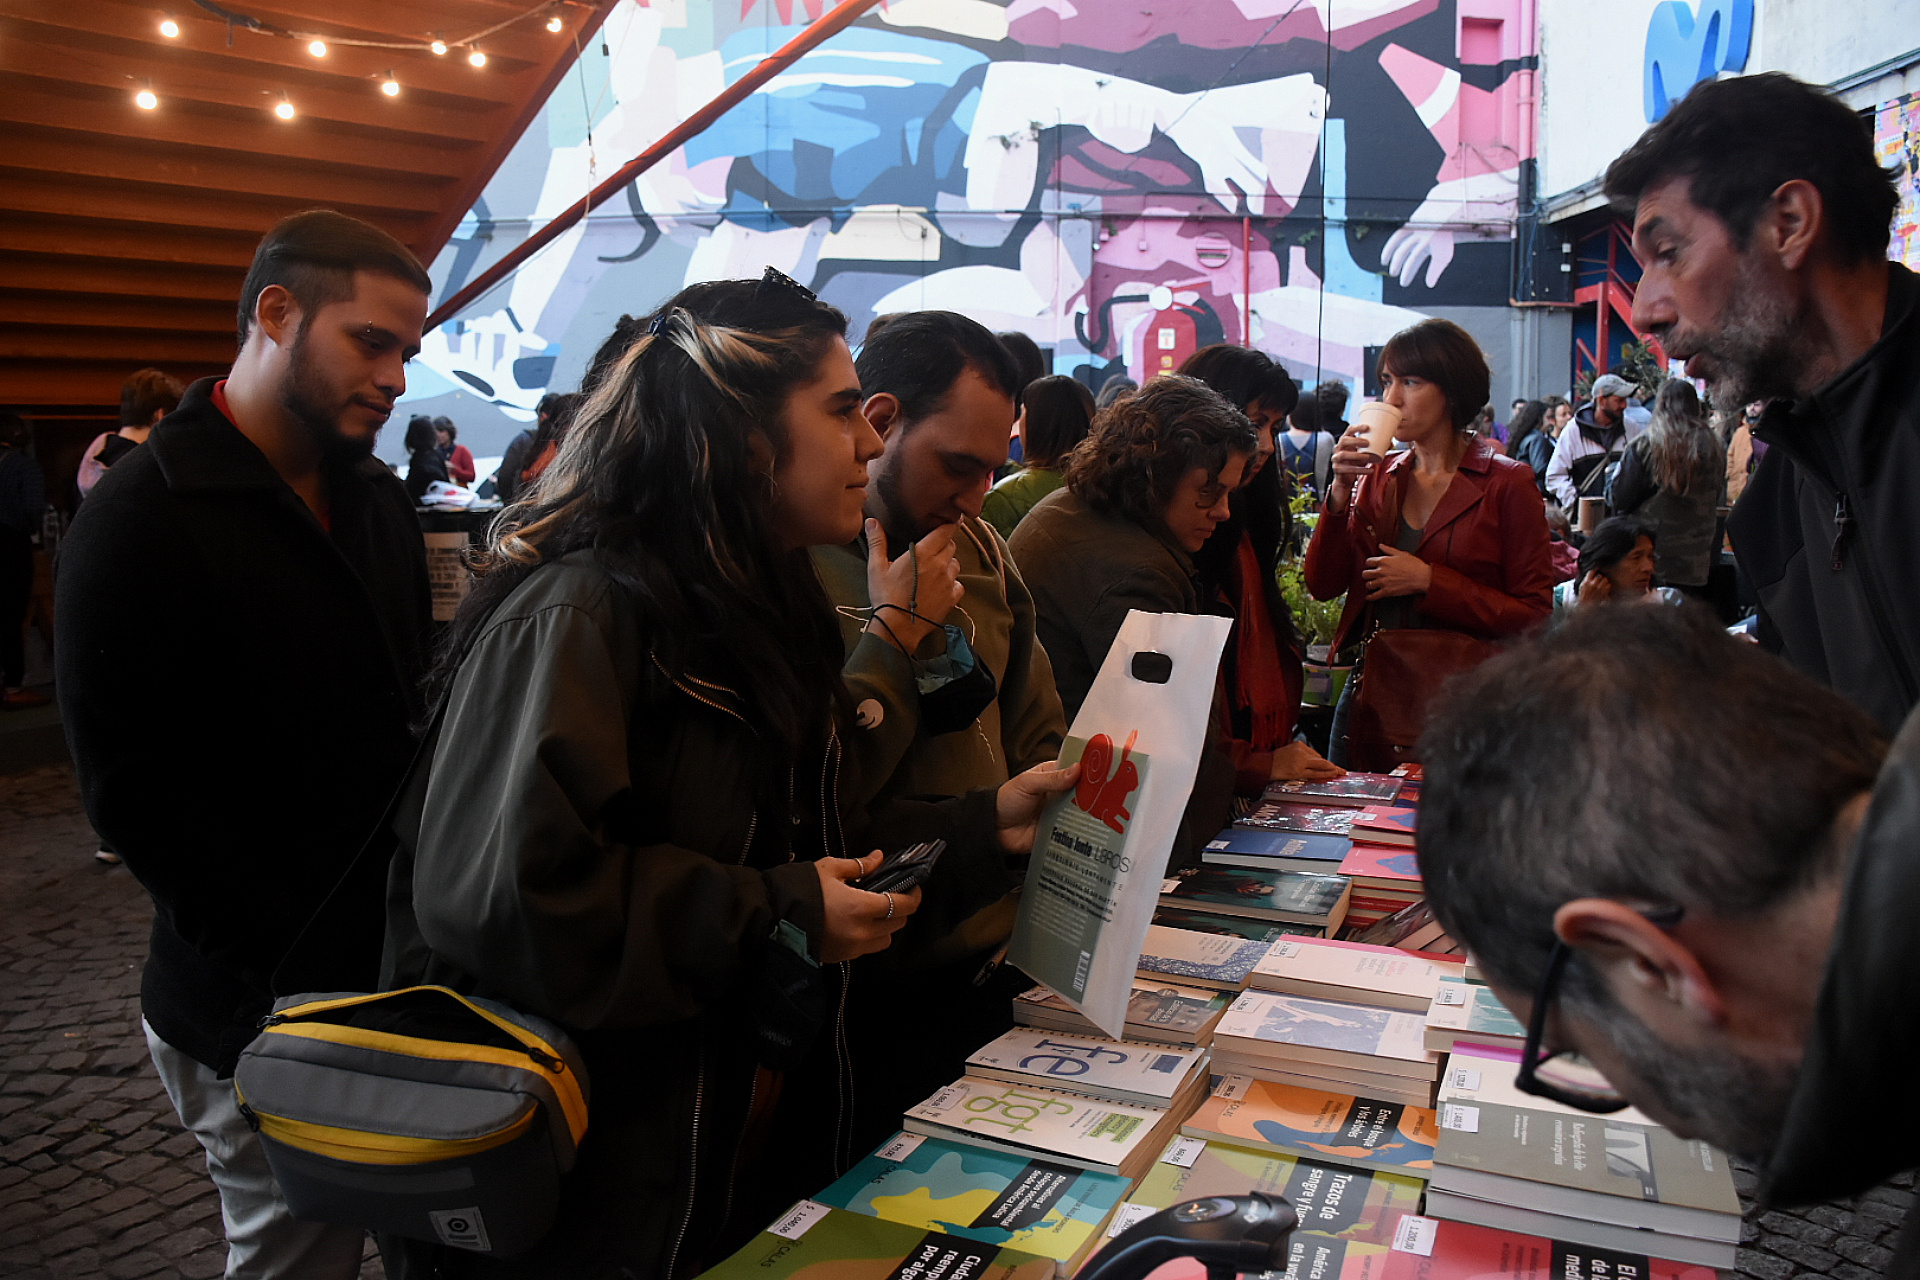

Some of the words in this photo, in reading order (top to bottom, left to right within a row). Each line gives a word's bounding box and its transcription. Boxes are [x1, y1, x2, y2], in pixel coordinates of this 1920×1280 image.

[1376, 1109, 1392, 1125] Entre
[1347, 1118, 1369, 1138] árboles
[1363, 1129, 1385, 1147] bosque
[870, 1163, 897, 1184] CALAS
[1024, 1169, 1042, 1185] desde
[1033, 1172, 1053, 1191] colapso
[1173, 1170, 1192, 1192] CALAS
[1036, 1175, 1067, 1204] Alternativas
[1302, 1169, 1323, 1197] sangre
[1325, 1174, 1353, 1208] Trazos
[1006, 1183, 1030, 1204] América
[992, 1202, 1013, 1219] Latina
[1000, 1190, 1037, 1227] socioambiental
[1030, 1202, 1041, 1210] al
[1319, 1206, 1340, 1220] de
[920, 1244, 940, 1262] por
[1292, 1242, 1305, 1253] en
[760, 1246, 790, 1268] CALAS
[1289, 1254, 1305, 1262] la
[1310, 1246, 1331, 1280] América
[1591, 1259, 1611, 1273] de
[1617, 1264, 1637, 1276] El
